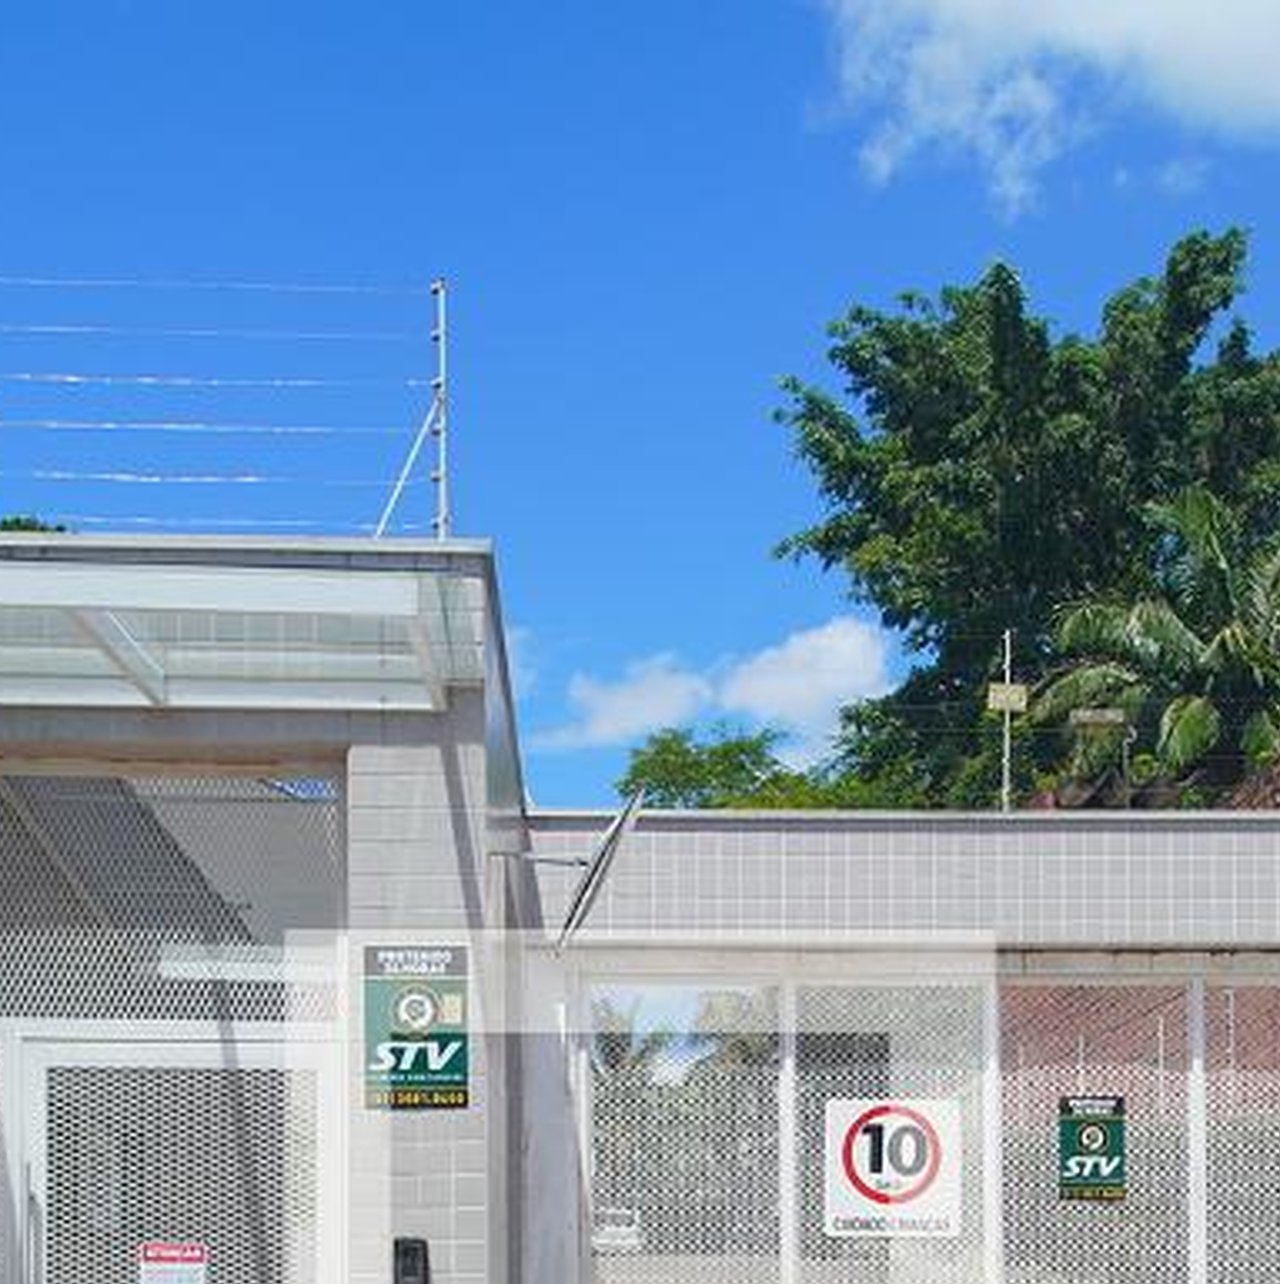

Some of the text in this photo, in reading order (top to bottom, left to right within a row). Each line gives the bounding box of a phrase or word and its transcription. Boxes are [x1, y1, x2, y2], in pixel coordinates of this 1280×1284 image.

[369, 1040, 463, 1071] STV
[861, 1123, 929, 1177] 10
[1062, 1155, 1122, 1178] STV
